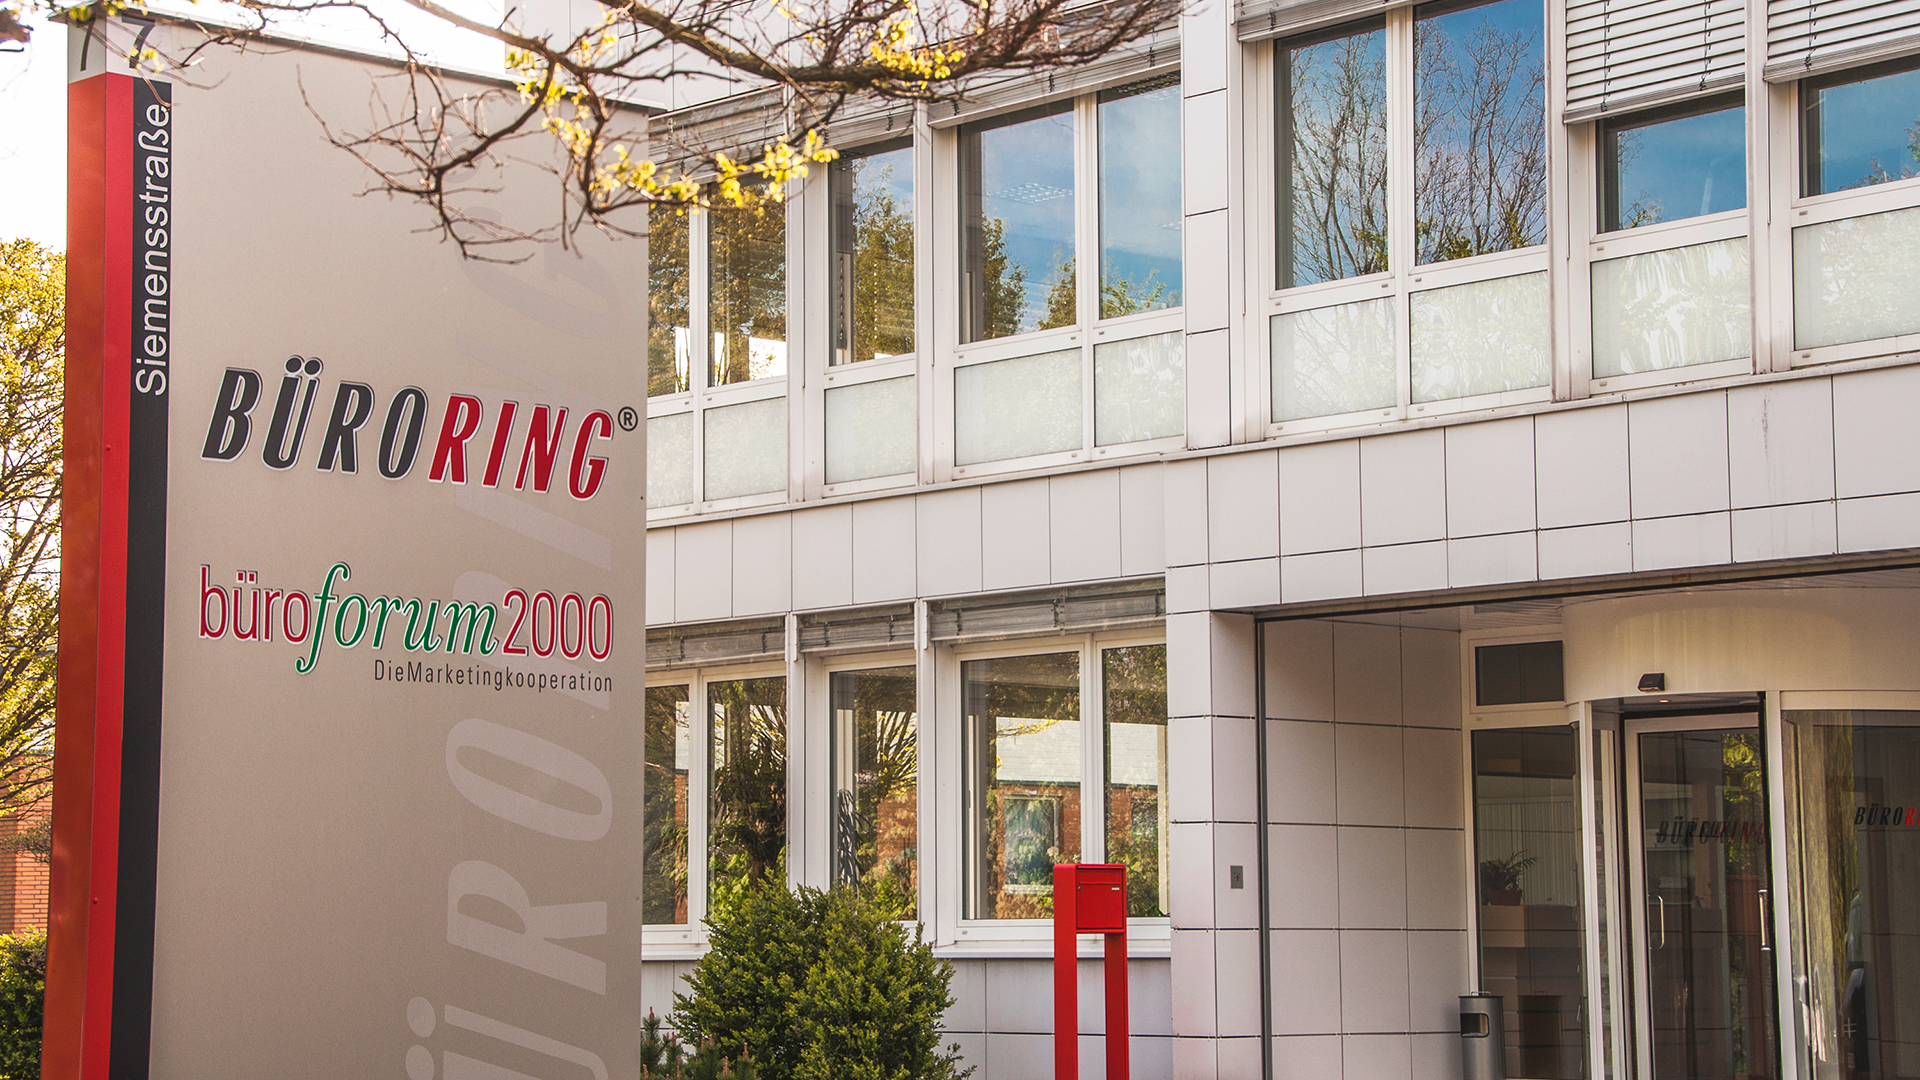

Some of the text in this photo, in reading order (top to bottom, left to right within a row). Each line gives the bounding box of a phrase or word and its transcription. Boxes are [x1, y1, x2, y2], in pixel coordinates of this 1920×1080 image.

[121, 15, 156, 70] 7
[135, 103, 170, 397] Siemensstraße
[199, 561, 614, 674] büroforum2000
[373, 658, 613, 693] DieMarketingkooperation
